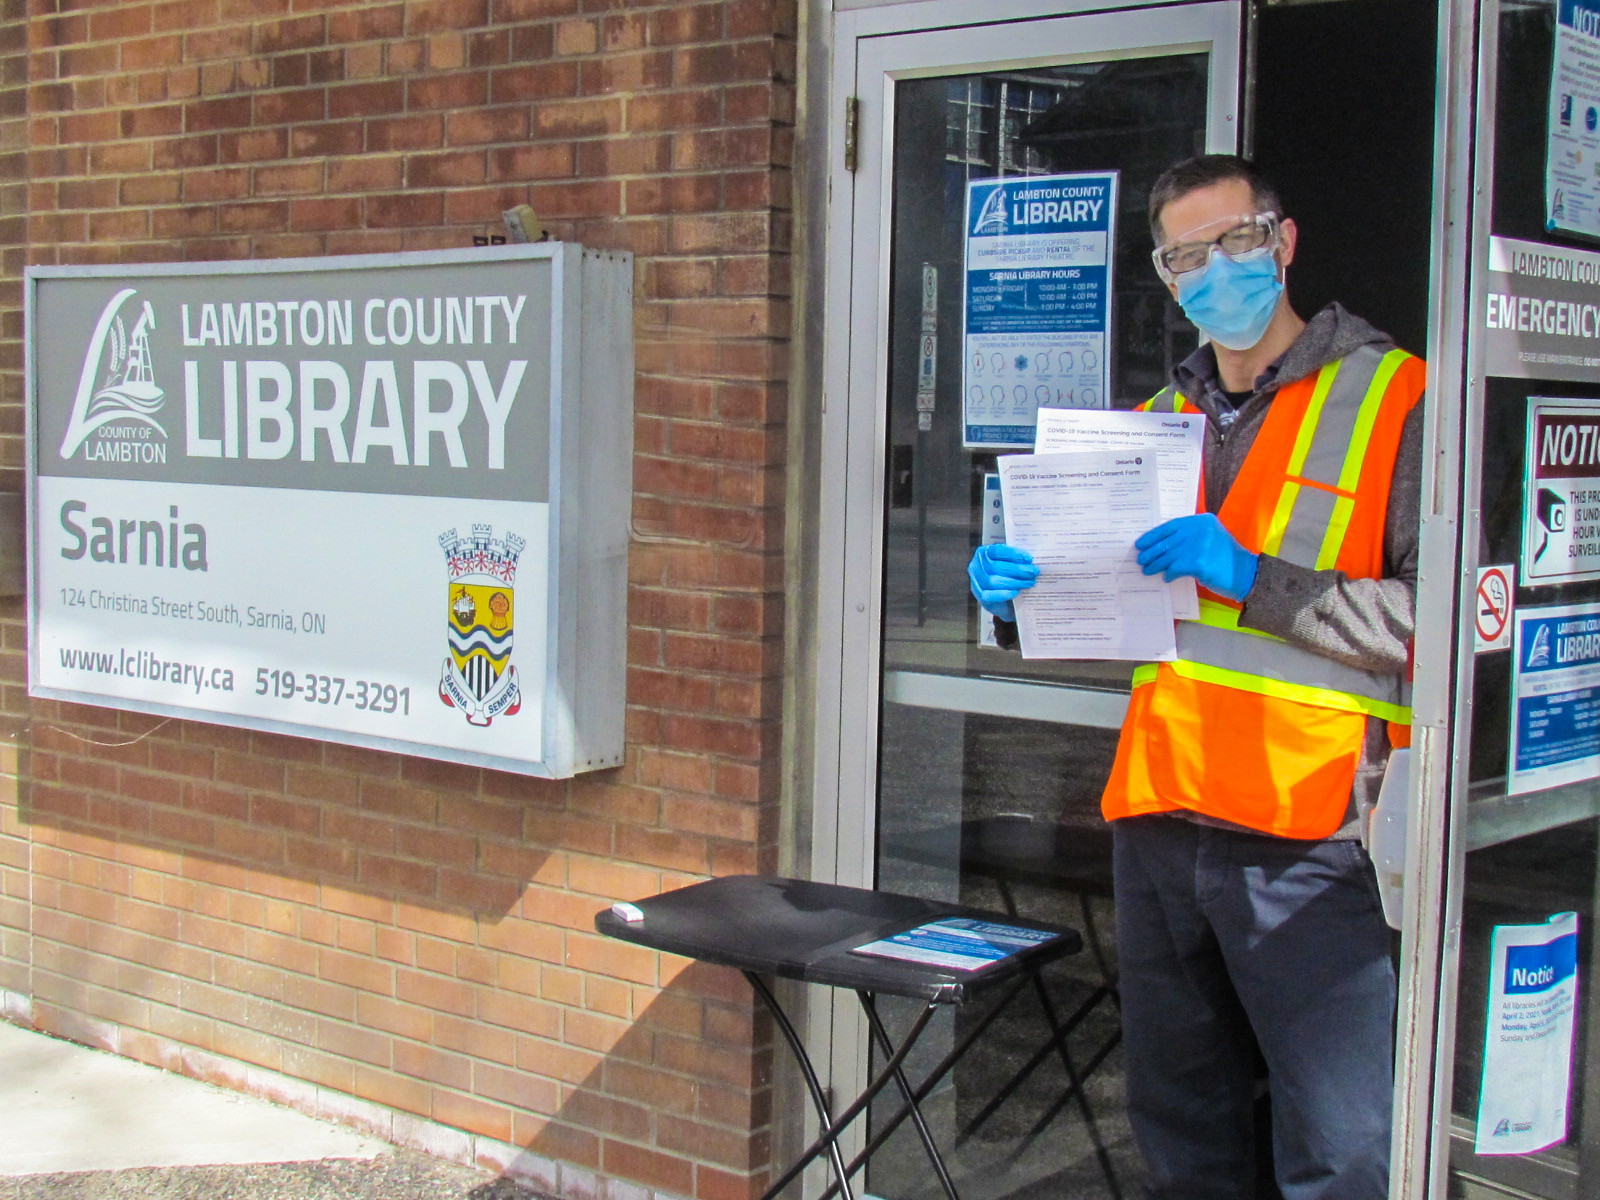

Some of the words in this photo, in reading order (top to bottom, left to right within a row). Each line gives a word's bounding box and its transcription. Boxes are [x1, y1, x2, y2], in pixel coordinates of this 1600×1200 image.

[1014, 190, 1060, 200] LAMBTON
[1062, 186, 1104, 198] COUNTY
[1013, 200, 1103, 225] LIBRARY
[989, 272, 1017, 280] SARNIA
[1019, 270, 1051, 279] LIBRARY
[1052, 269, 1080, 278] HOURS
[1513, 251, 1572, 281] LAMBTON
[1577, 261, 1600, 285] COU
[182, 300, 353, 346] LAMBTON
[364, 295, 526, 344] COUNTY
[1486, 293, 1600, 338] EMERGENCY
[98, 426, 137, 438] COUNTY
[139, 428, 152, 438] OF
[184, 360, 528, 470] LIBRARY
[86, 441, 166, 464] LAMBTON
[1541, 425, 1600, 465] NOTI
[1570, 491, 1586, 503] THIS
[1575, 509, 1581, 521] IS
[1583, 508, 1600, 521] UND
[60, 500, 208, 572] Sarnia
[1573, 526, 1594, 539] HOUR
[61, 588, 85, 607] 124
[90, 590, 147, 614] Christina
[152, 596, 193, 619] Street
[197, 601, 242, 628] South,
[248, 606, 296, 634] Sarnia,
[302, 612, 325, 634] ON
[60, 648, 234, 694] www.lclibrary.ca
[256, 668, 410, 716] 519-337-3291
[445, 674, 468, 709] SARNIA
[488, 683, 516, 714] SEMPER
